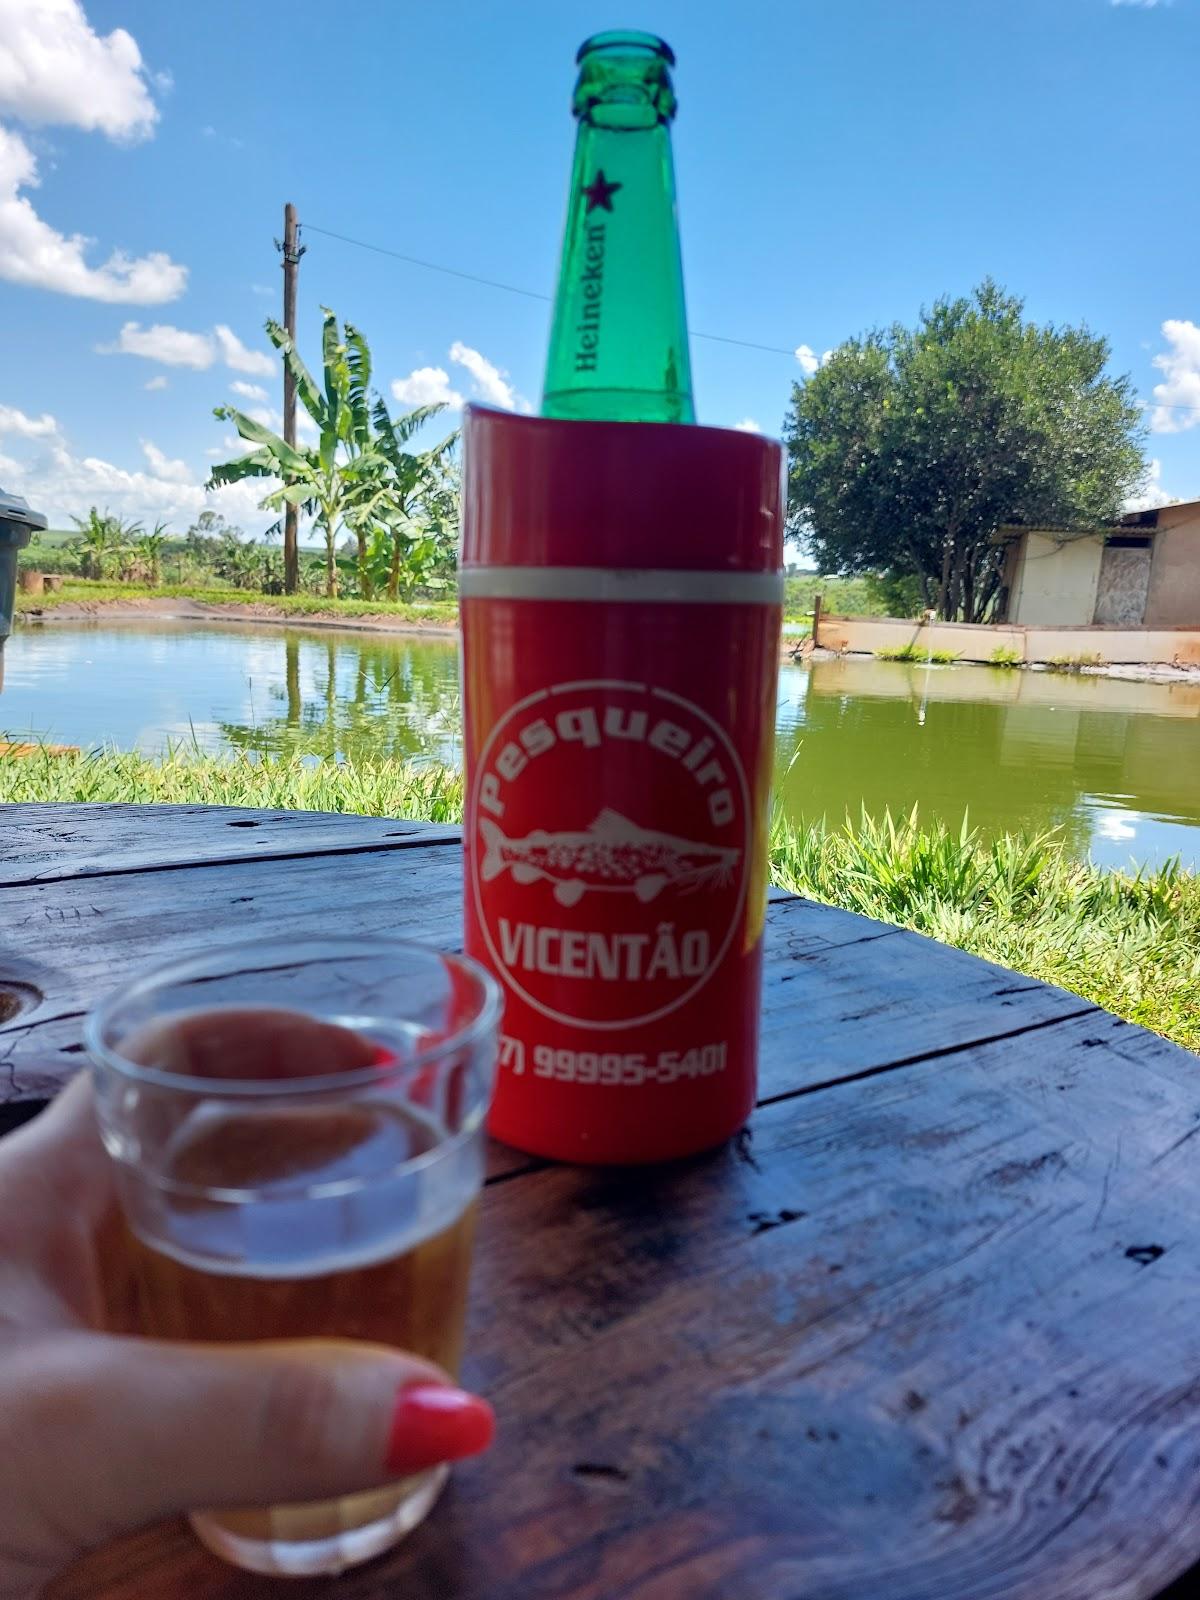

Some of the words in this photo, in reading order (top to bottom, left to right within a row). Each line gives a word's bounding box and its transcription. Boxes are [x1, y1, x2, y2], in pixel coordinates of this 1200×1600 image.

[576, 223, 605, 372] Heineken
[480, 706, 735, 826] Pesqueiro
[499, 919, 710, 981] VICENTÃO
[534, 1041, 727, 1086] 99995-5401
